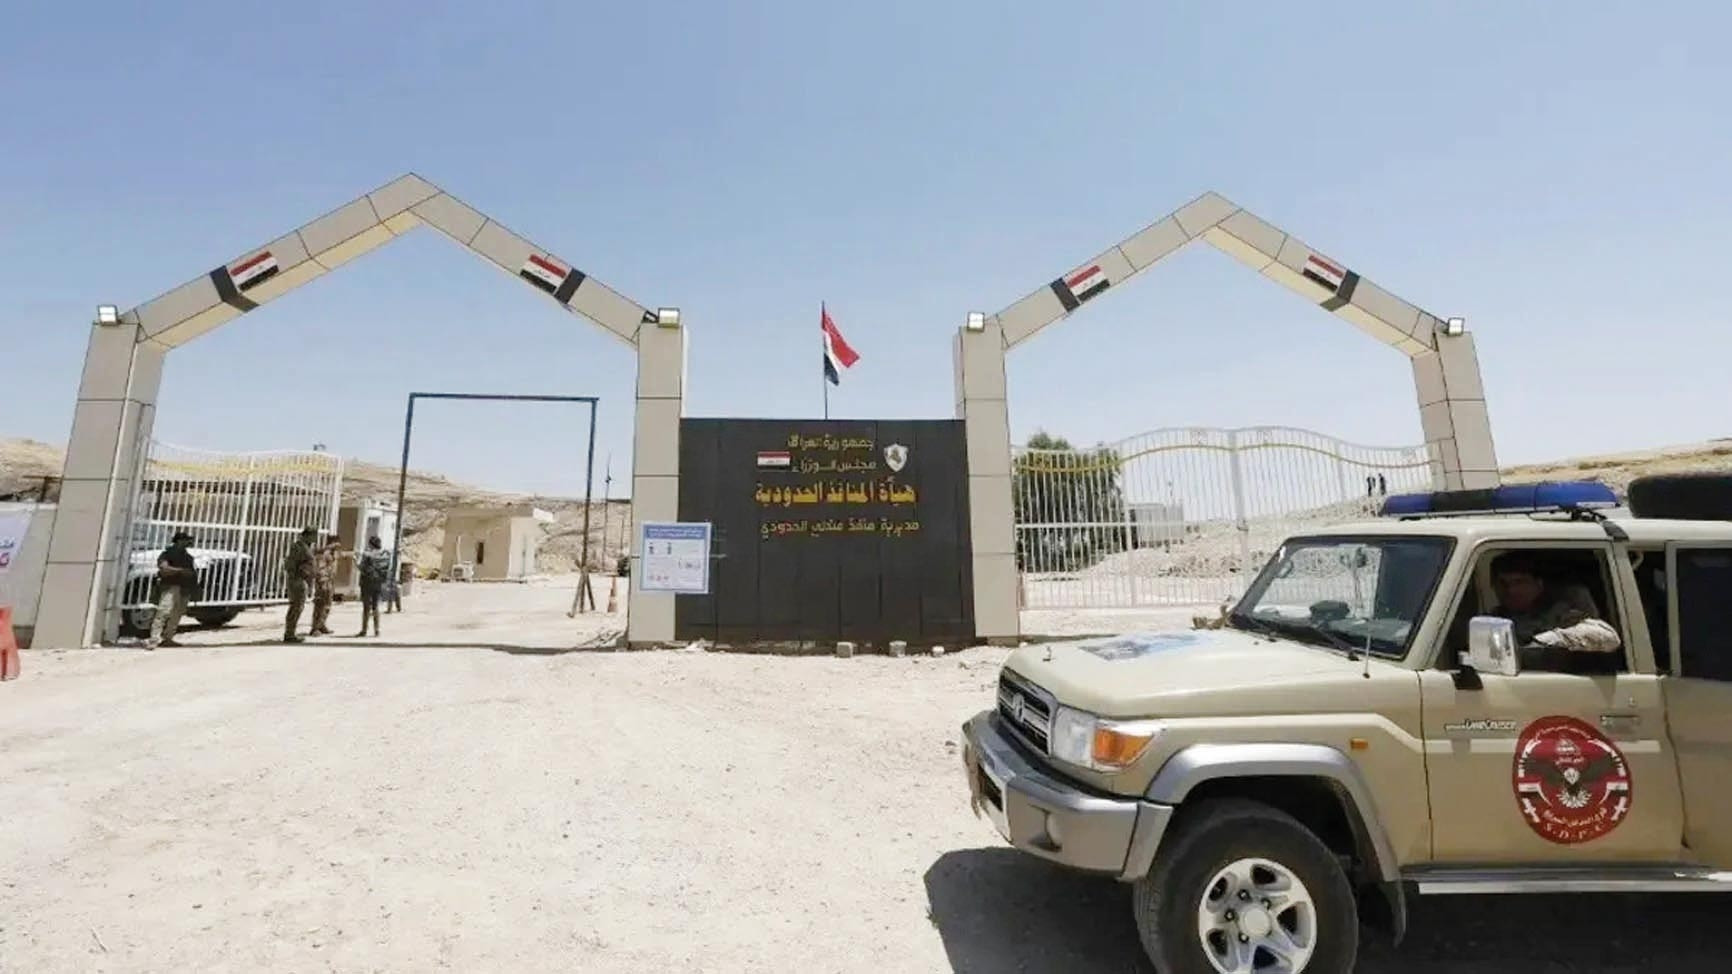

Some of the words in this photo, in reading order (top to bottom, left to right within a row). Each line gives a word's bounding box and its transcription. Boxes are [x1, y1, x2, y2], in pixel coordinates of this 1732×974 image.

[823, 433, 875, 451] جمهورية
[837, 458, 877, 474] مجلس
[755, 481, 823, 507] الحدودية
[826, 480, 874, 504] المنافذ
[880, 517, 920, 537] مديرية
